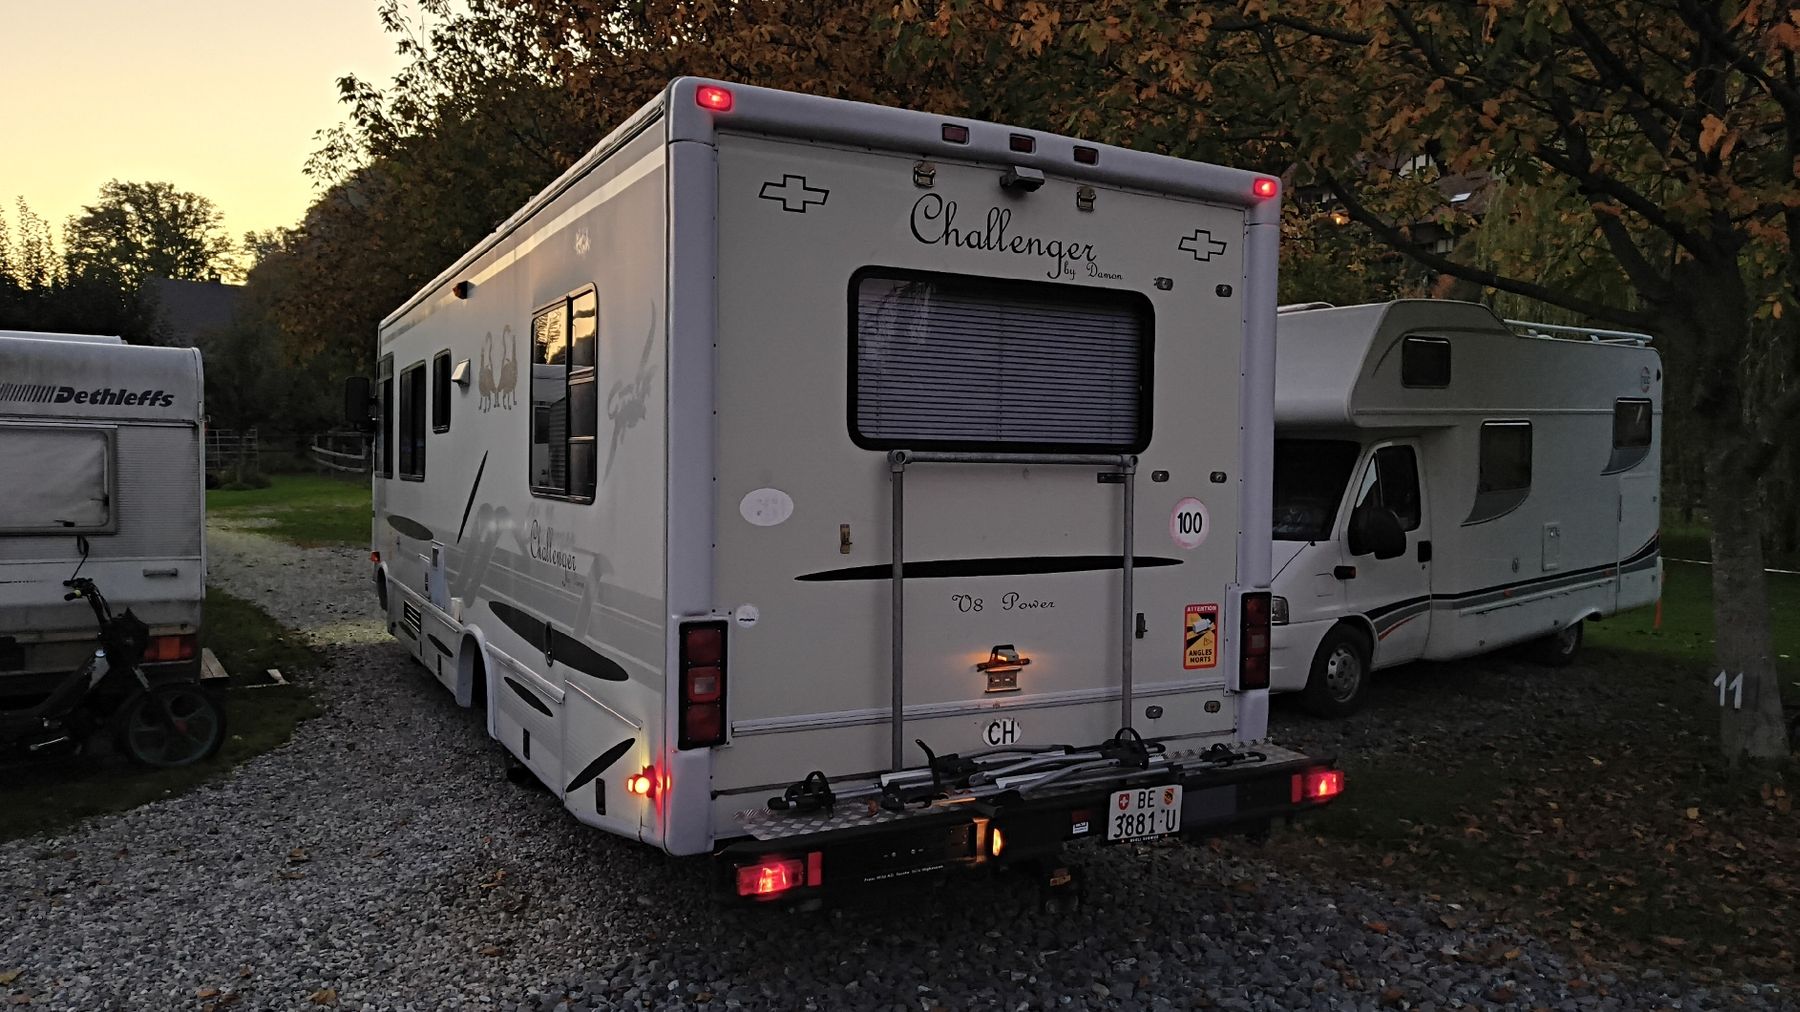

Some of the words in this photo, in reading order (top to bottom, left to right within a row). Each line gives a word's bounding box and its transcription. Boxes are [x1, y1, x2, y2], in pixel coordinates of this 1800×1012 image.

[910, 192, 1096, 280] Challenger
[1063, 260, 1076, 281] by
[1086, 261, 1124, 281] Damon
[53, 386, 174, 407] Dethleffs
[1177, 511, 1203, 535] 100
[530, 518, 577, 586] Challenger
[951, 594, 984, 613] V8
[1001, 591, 1056, 611] Power
[1188, 649, 1213, 657] ANGLES
[1189, 656, 1212, 664] MORTS
[1713, 669, 1744, 709] 11
[988, 720, 1014, 746] CH
[1138, 790, 1156, 810] BE
[1113, 811, 1156, 839] 3881
